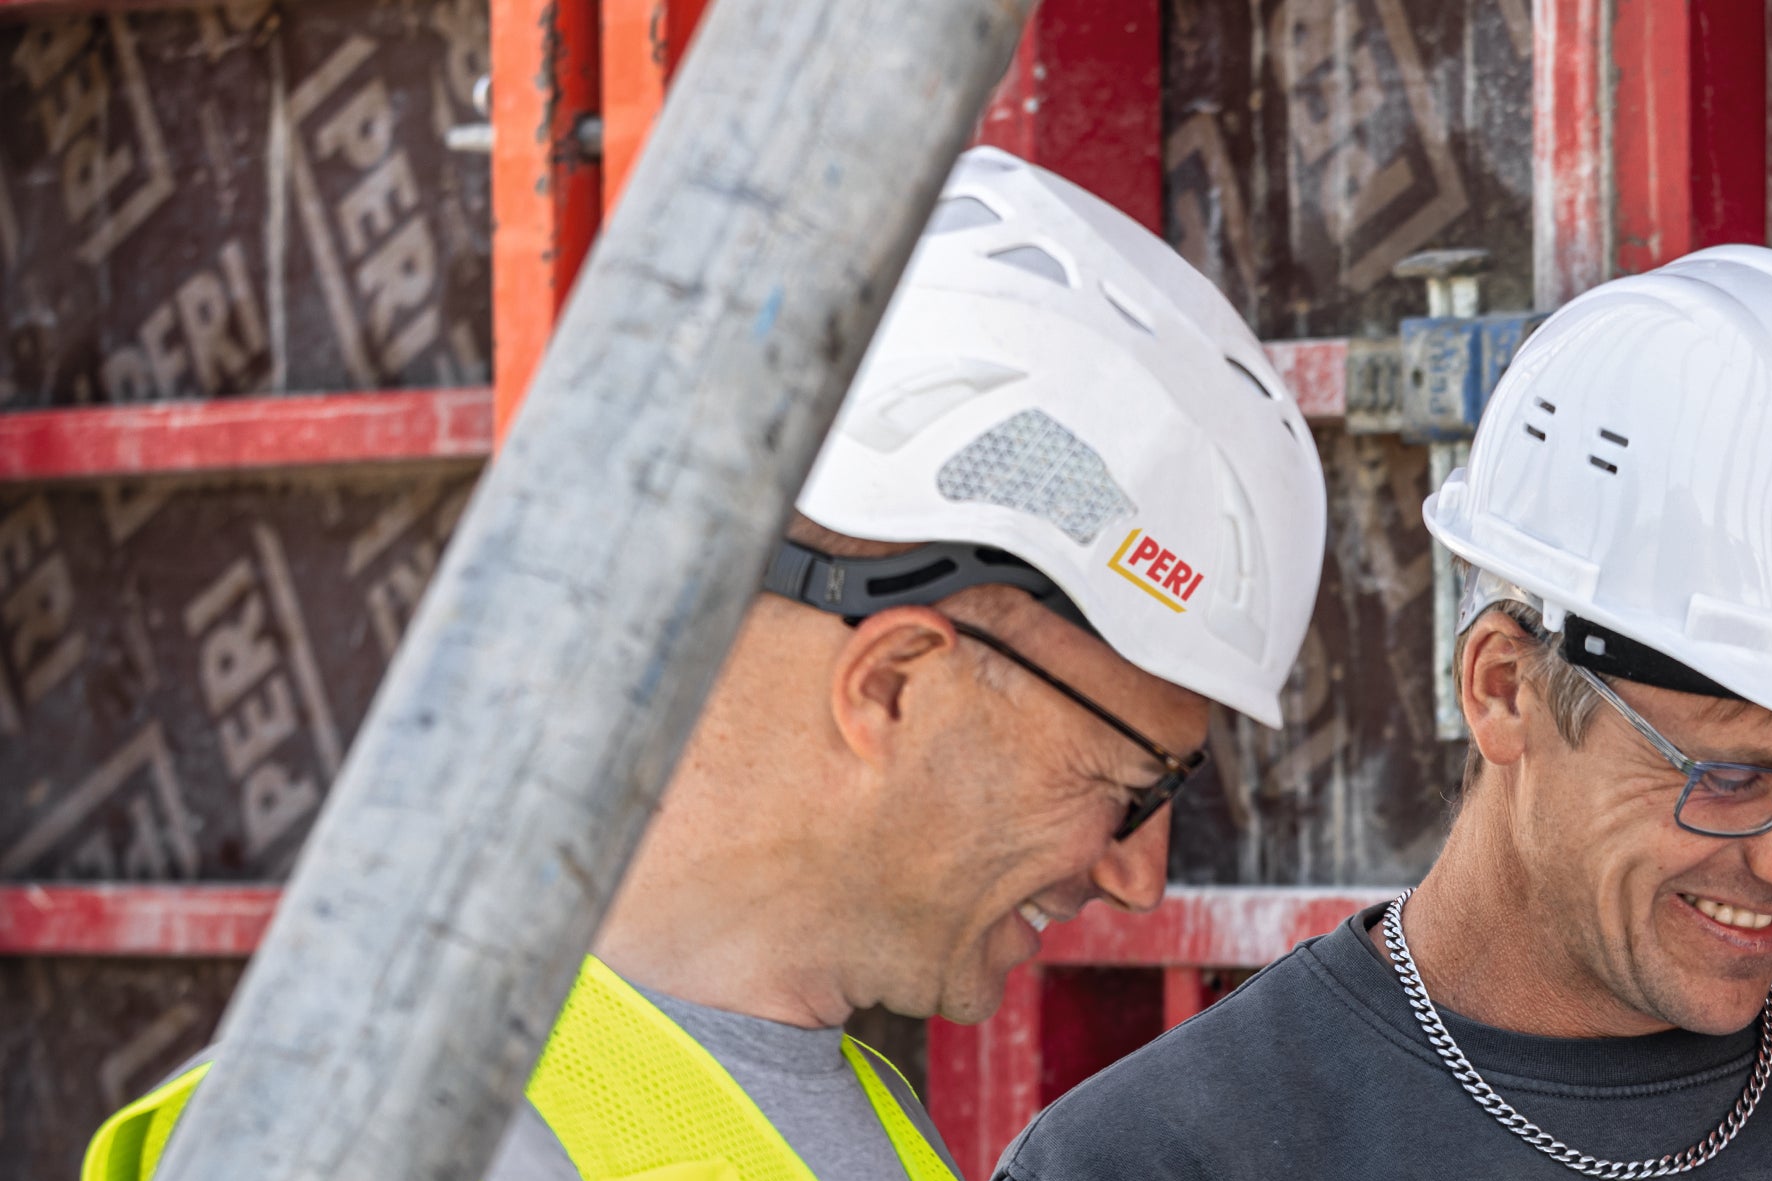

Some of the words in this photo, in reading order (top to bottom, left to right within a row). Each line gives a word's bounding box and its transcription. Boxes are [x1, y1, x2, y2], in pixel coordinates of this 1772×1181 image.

[316, 77, 440, 373] PERI
[184, 556, 320, 862] PERI
[1128, 536, 1204, 602] PERI
